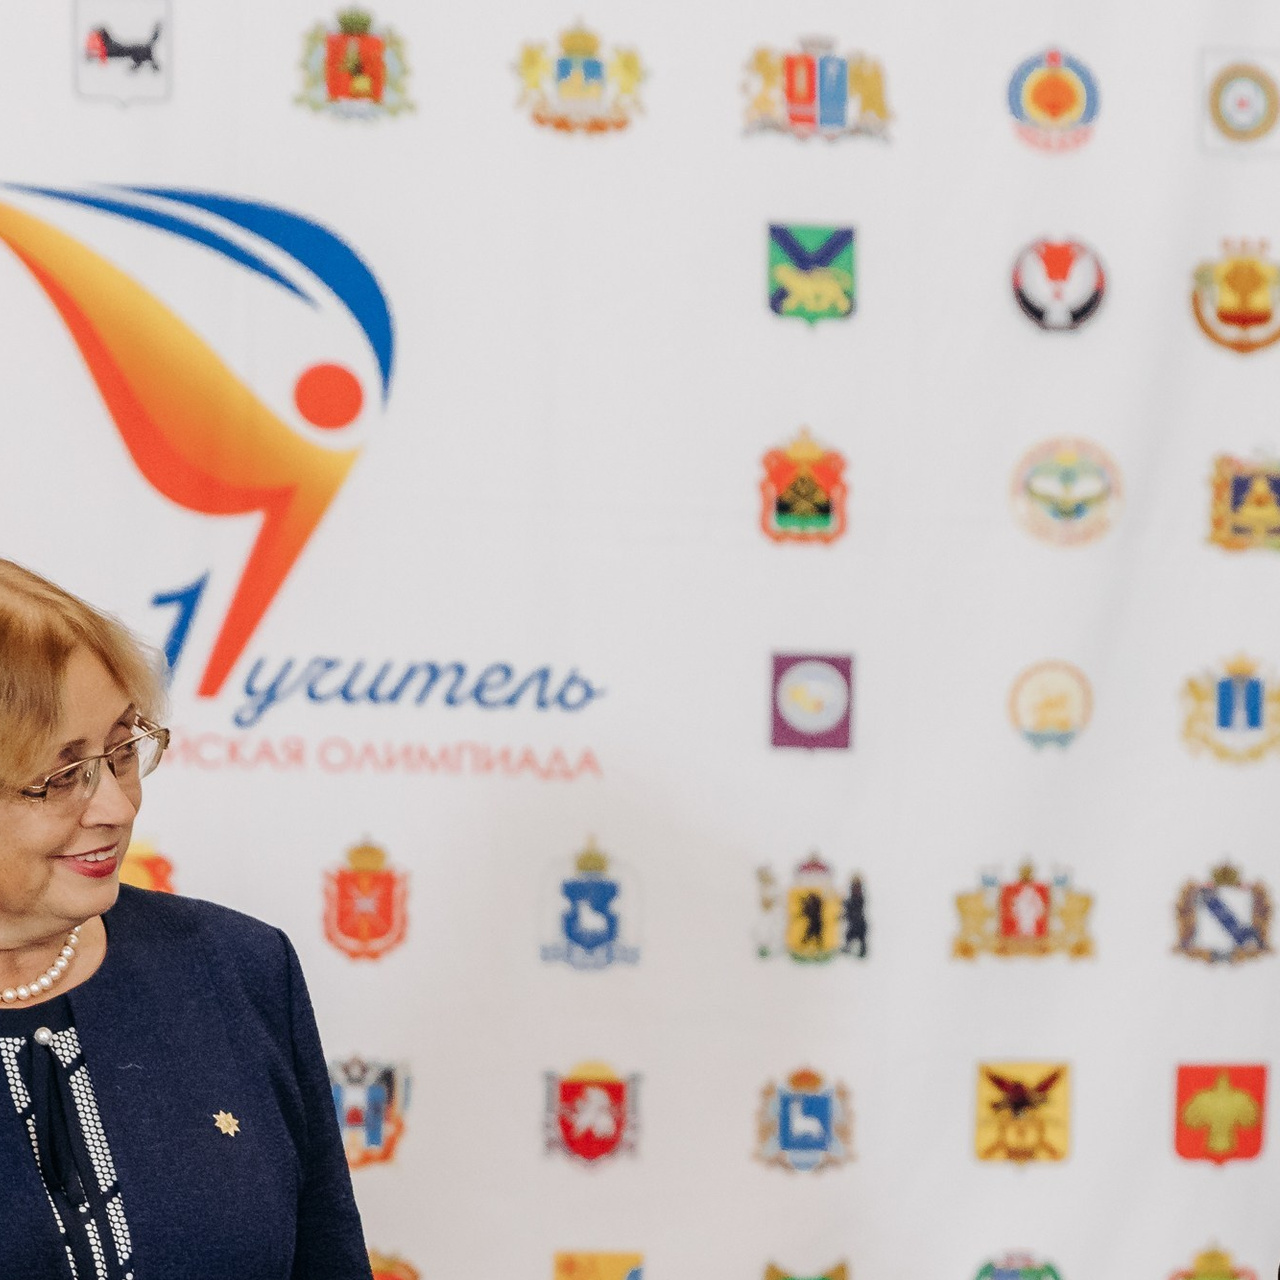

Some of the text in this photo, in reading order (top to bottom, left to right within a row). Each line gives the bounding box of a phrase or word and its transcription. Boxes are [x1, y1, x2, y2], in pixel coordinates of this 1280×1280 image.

[234, 651, 604, 728] учитель
[162, 728, 604, 783] ЙСКАЯ ОЛИМПИАДА
